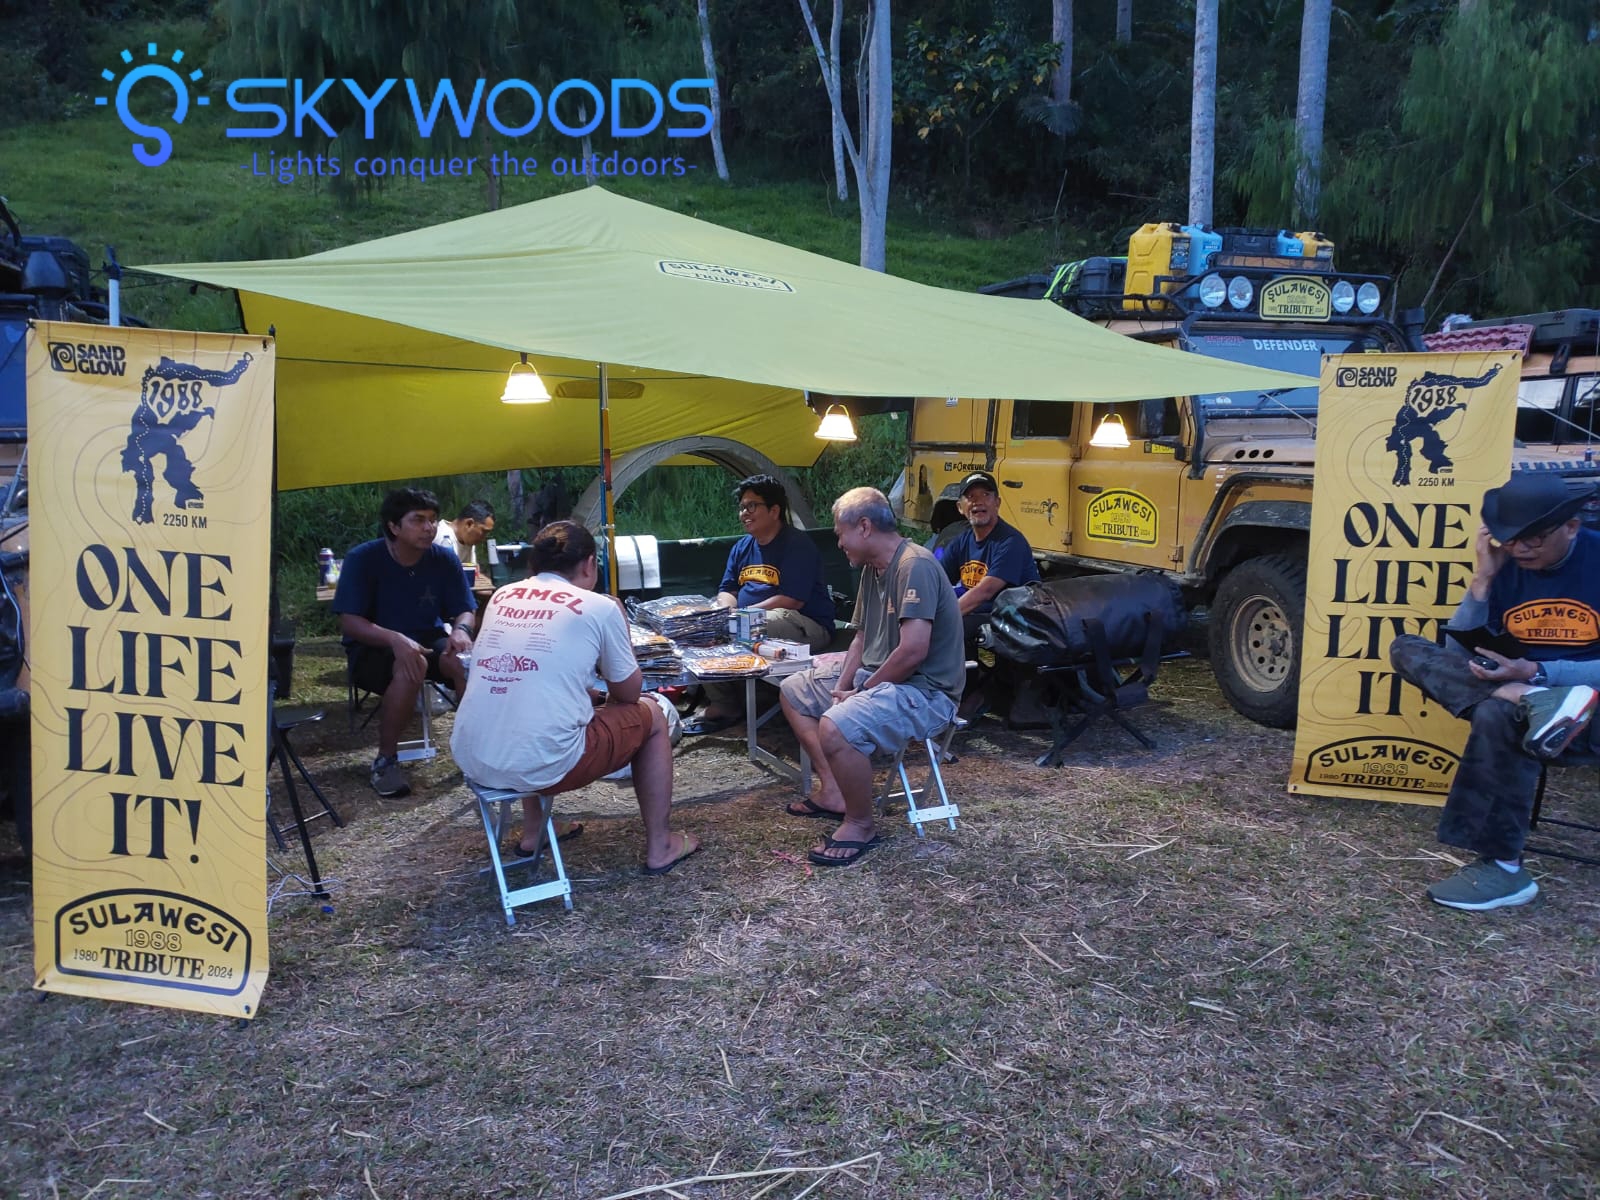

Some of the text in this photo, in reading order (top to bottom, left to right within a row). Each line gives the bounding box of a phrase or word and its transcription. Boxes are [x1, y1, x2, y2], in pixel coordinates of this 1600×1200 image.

[1267, 283, 1325, 302] SULAWESI
[1278, 304, 1314, 314] TRIBUTE
[78, 344, 125, 361] SAND
[1253, 339, 1318, 351] DEFENDER
[77, 359, 126, 376] GLOW
[1359, 367, 1397, 377] SAND
[1359, 376, 1397, 387] GLOW
[150, 381, 203, 417] 1988
[1411, 386, 1457, 413] 1988
[1418, 477, 1455, 487] 2250 KM
[1092, 497, 1152, 522] SULAWESI
[163, 513, 207, 529] 2250 KM
[1102, 523, 1139, 537] TRIBUTE
[1343, 502, 1471, 549] ONE
[75, 543, 233, 622] ONE
[1331, 559, 1473, 606] LIFE
[493, 587, 583, 615] CAMEL
[496, 606, 560, 620] TROPHY
[1513, 606, 1590, 624] SULAWESI
[1324, 614, 1450, 660] LIV
[1526, 628, 1578, 638] TRIBUTE
[67, 625, 243, 705] LIFE
[64, 707, 245, 787] LIVE
[1319, 745, 1455, 775] SULAWESI
[1362, 763, 1408, 775] 1988
[1341, 773, 1425, 789] TRIBUTE
[109, 792, 202, 864] IT!
[69, 902, 238, 952] SULAWESI
[125, 929, 182, 952] 1988
[73, 947, 233, 980] 1980 TRIBUTE 2024
